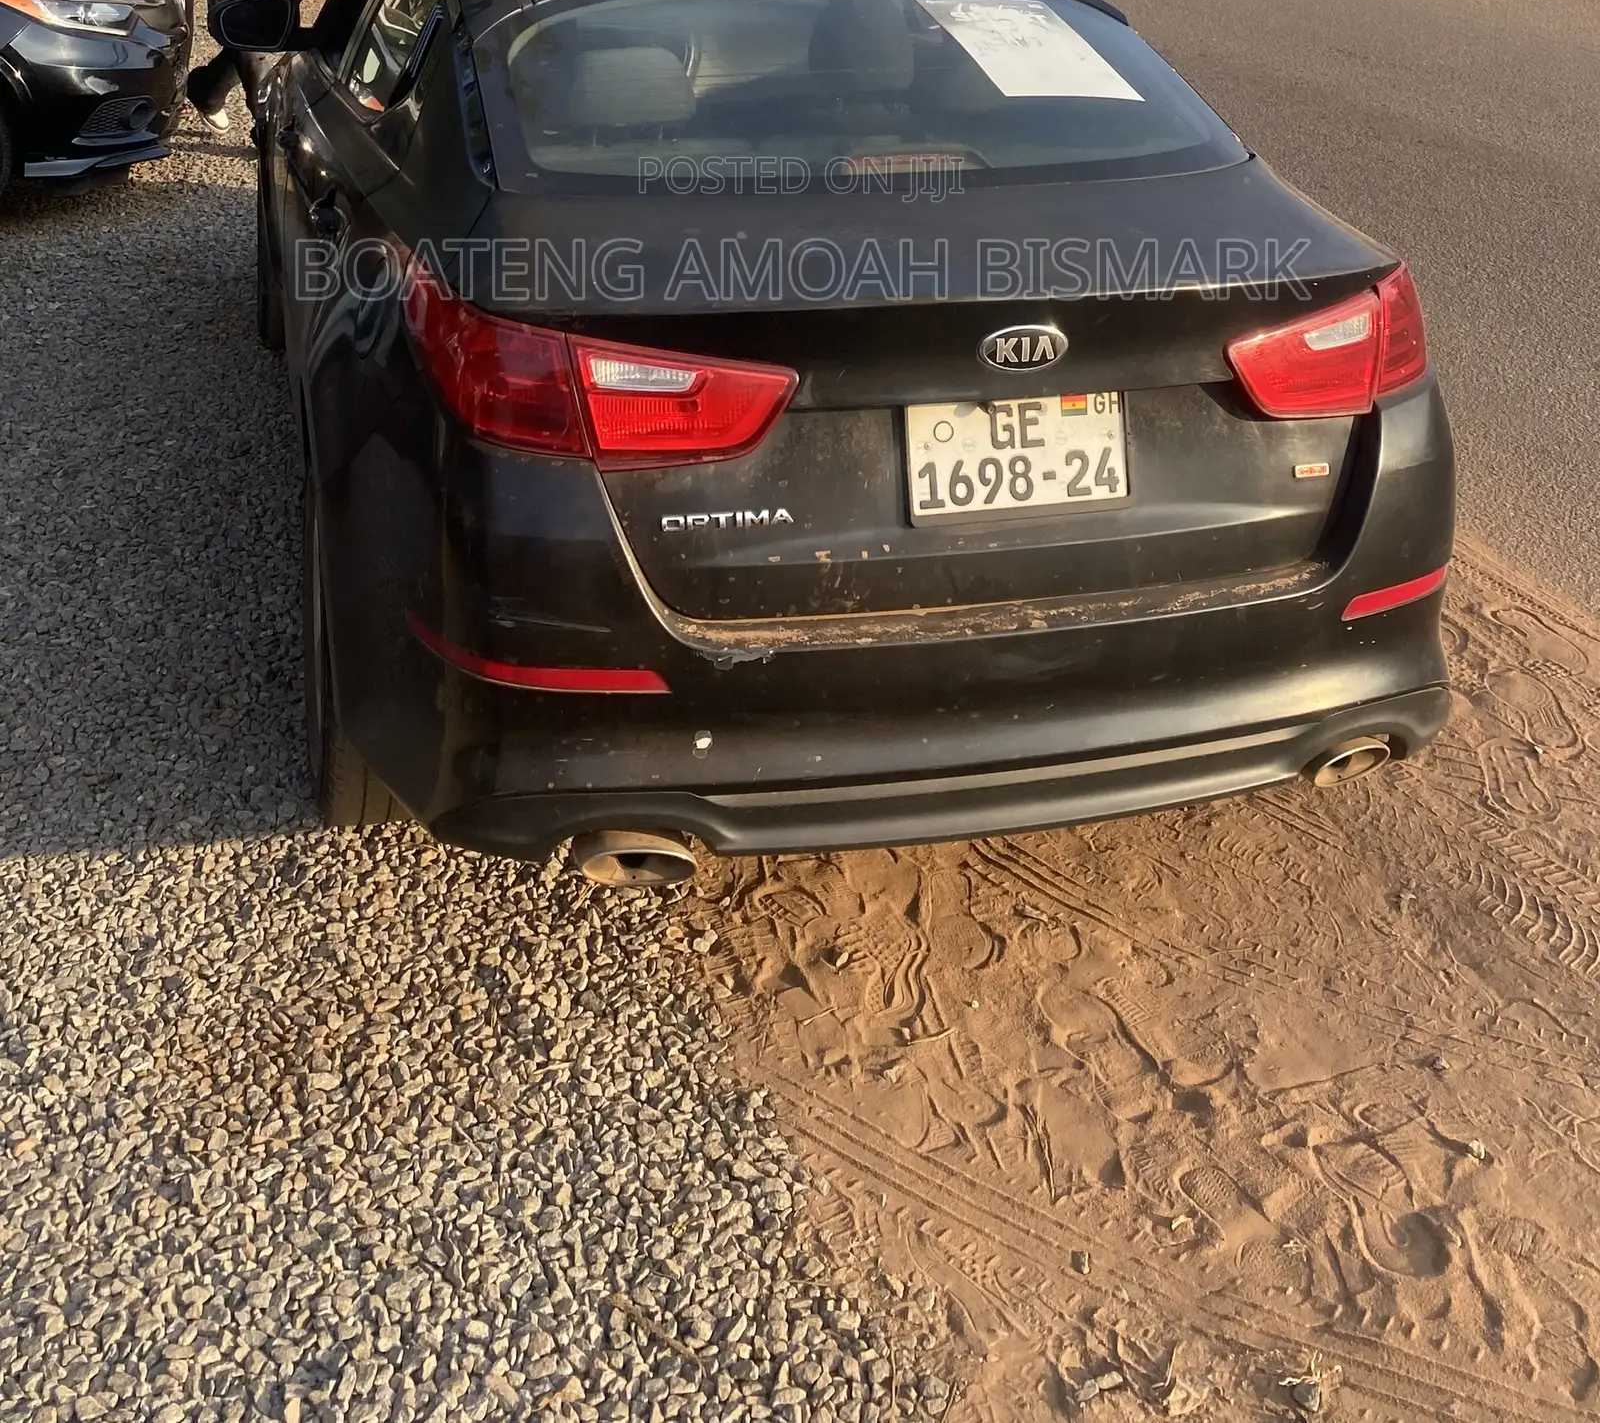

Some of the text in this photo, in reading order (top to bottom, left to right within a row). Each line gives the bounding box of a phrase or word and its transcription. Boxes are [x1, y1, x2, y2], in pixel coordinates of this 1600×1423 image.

[995, 335, 1056, 363] KIA
[1093, 391, 1121, 416] GH
[990, 401, 1046, 450] GE
[917, 446, 1121, 510] 1698-24
[660, 508, 796, 532] OPTIMA
